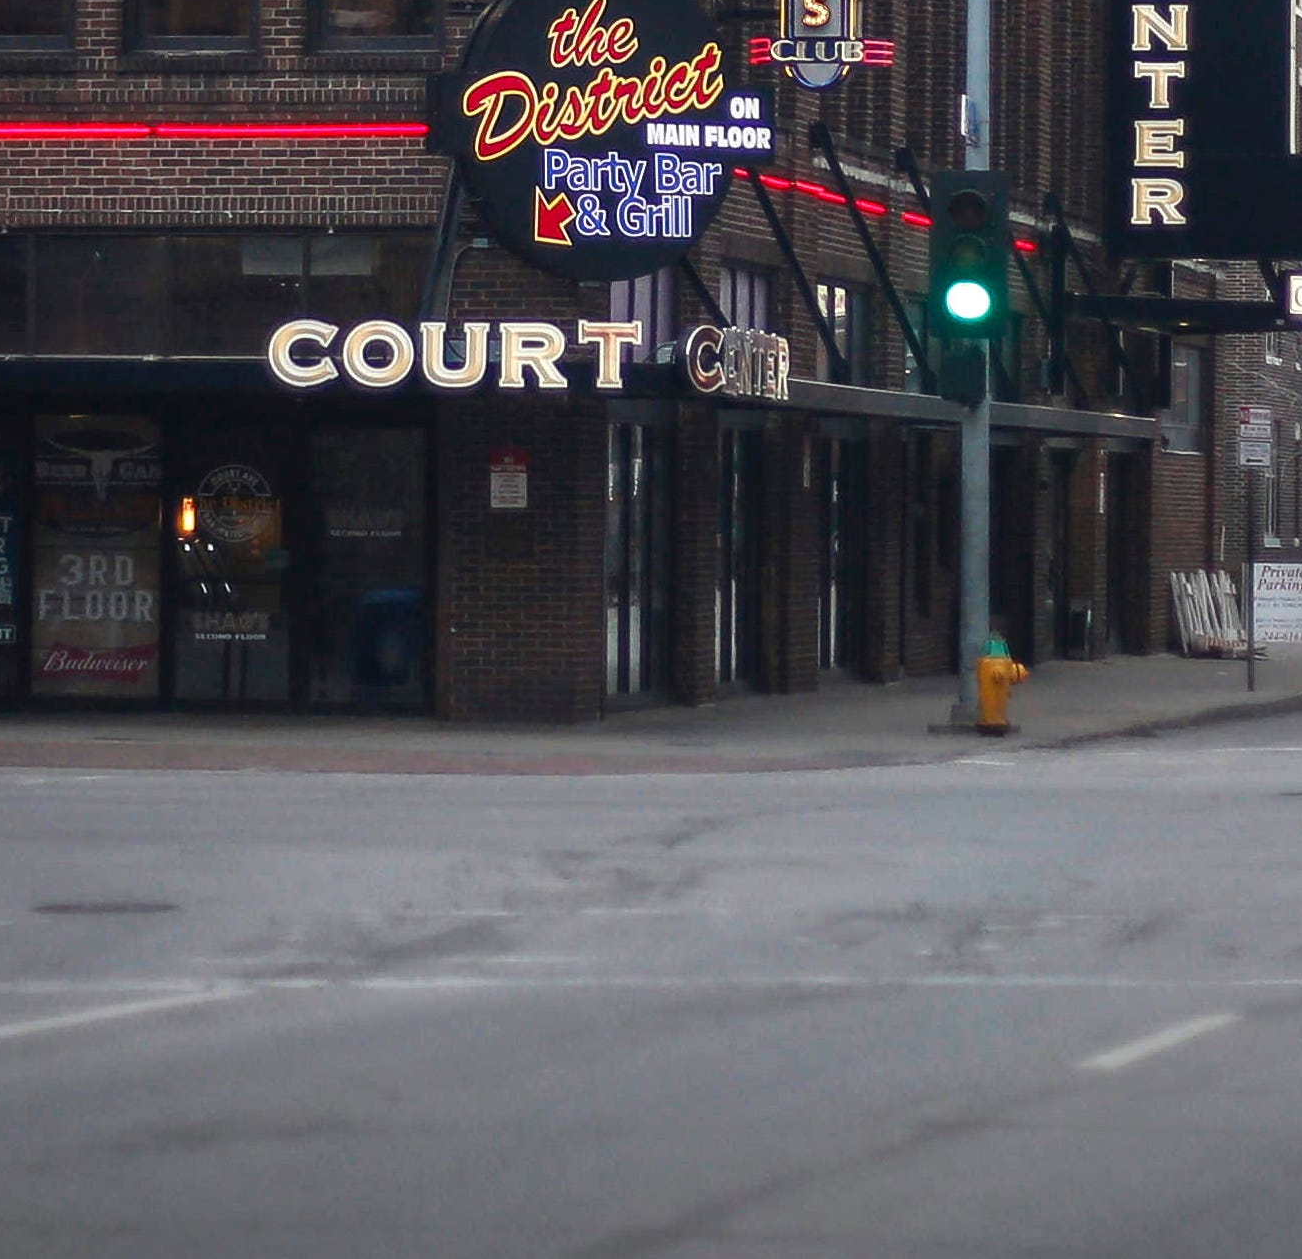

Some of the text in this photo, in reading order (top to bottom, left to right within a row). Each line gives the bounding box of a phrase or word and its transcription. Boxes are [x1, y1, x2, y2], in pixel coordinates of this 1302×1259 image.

[770, 39, 865, 63] CLUB
[462, 42, 725, 162] District
[729, 96, 761, 120] ON
[645, 123, 772, 150] MAIN FLOOR
[543, 148, 723, 199] Party Bar
[574, 193, 693, 239] & Grill
[267, 318, 643, 389] COURT
[58, 553, 135, 587] 3RD
[36, 590, 155, 623] FLOOR
[42, 649, 149, 673] Budweiser
